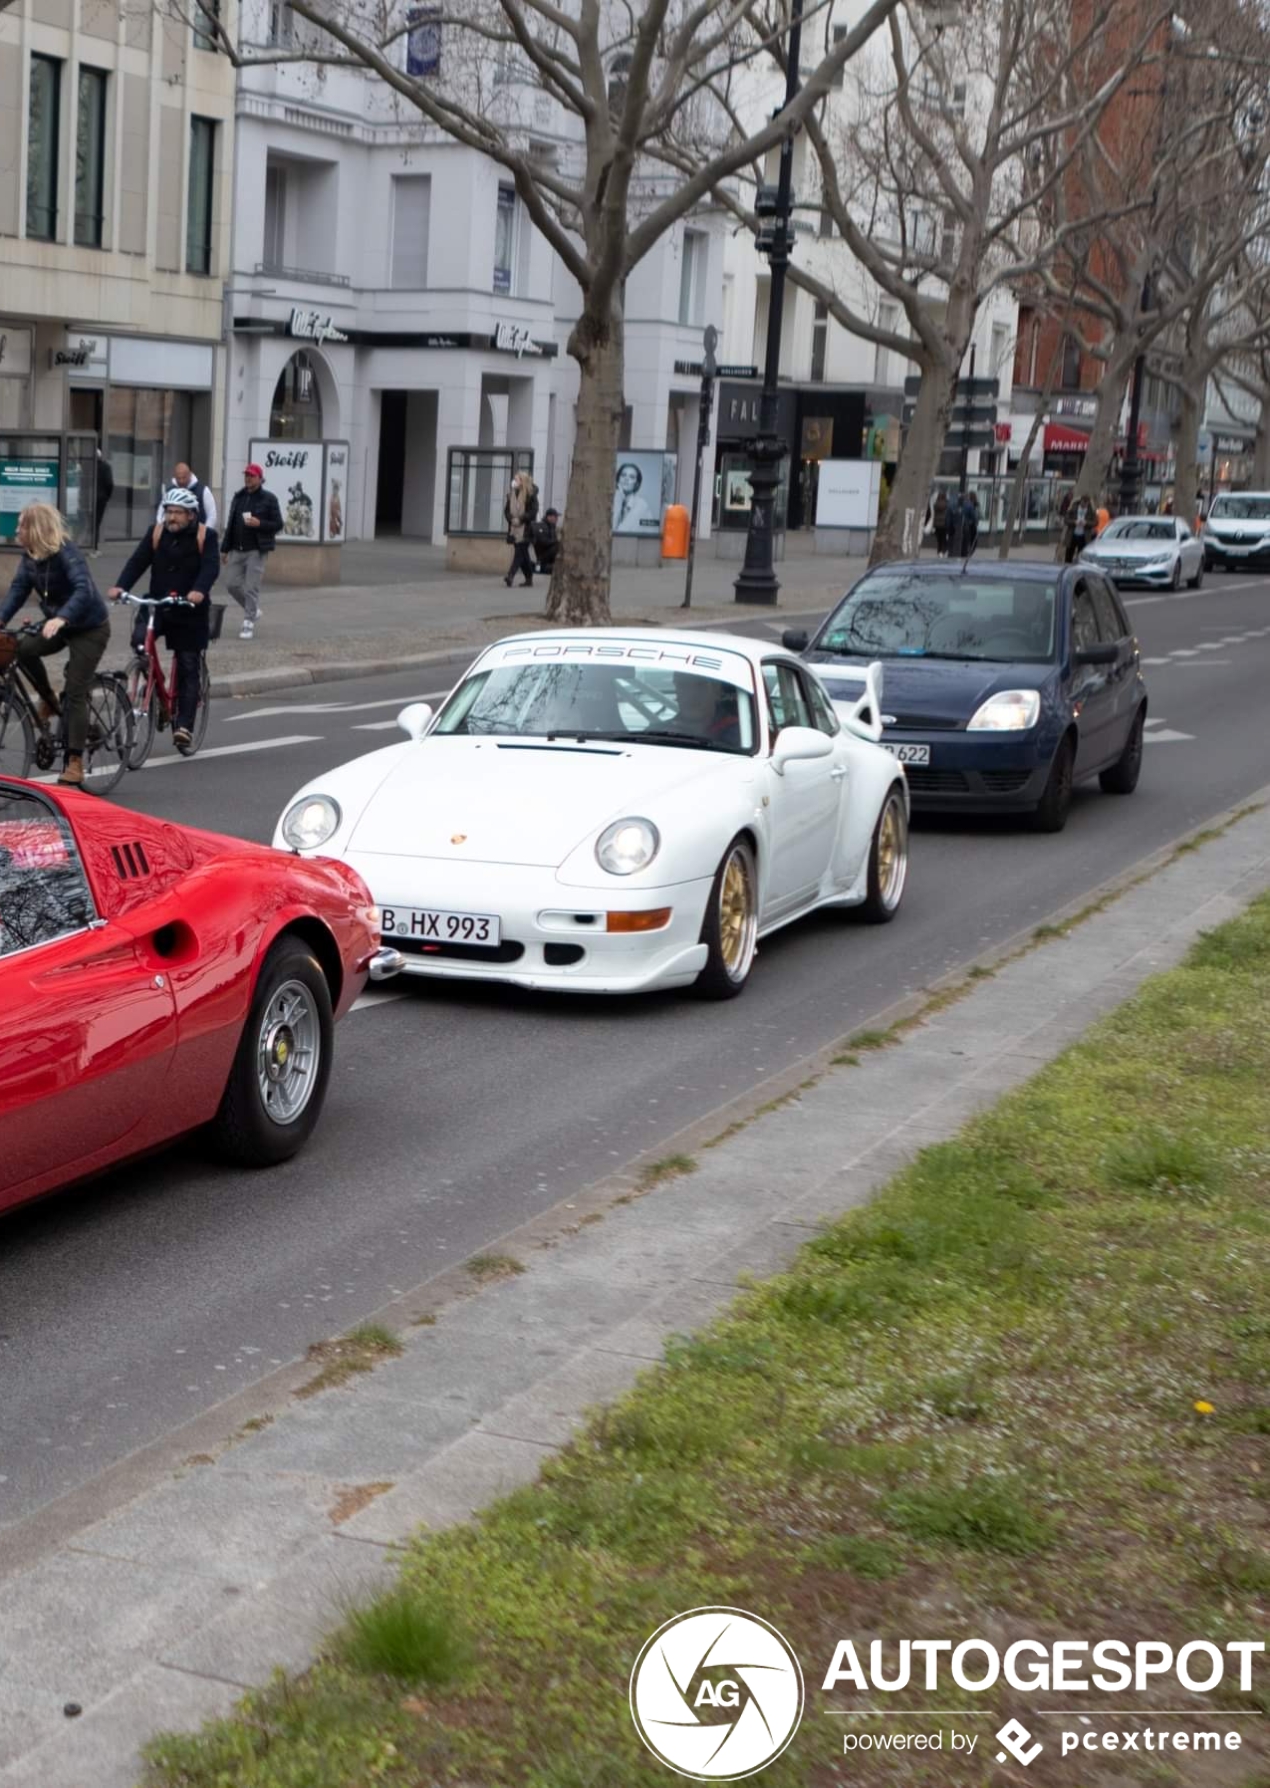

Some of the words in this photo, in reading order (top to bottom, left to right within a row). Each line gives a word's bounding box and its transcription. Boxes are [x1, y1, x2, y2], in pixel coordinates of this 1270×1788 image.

[54, 351, 88, 366] Steiff
[265, 450, 309, 469] Steiff
[502, 645, 723, 671] PORSCHE
[897, 746, 928, 762] 622
[382, 909, 395, 931] B
[411, 912, 440, 937] HX
[446, 915, 490, 941] 993
